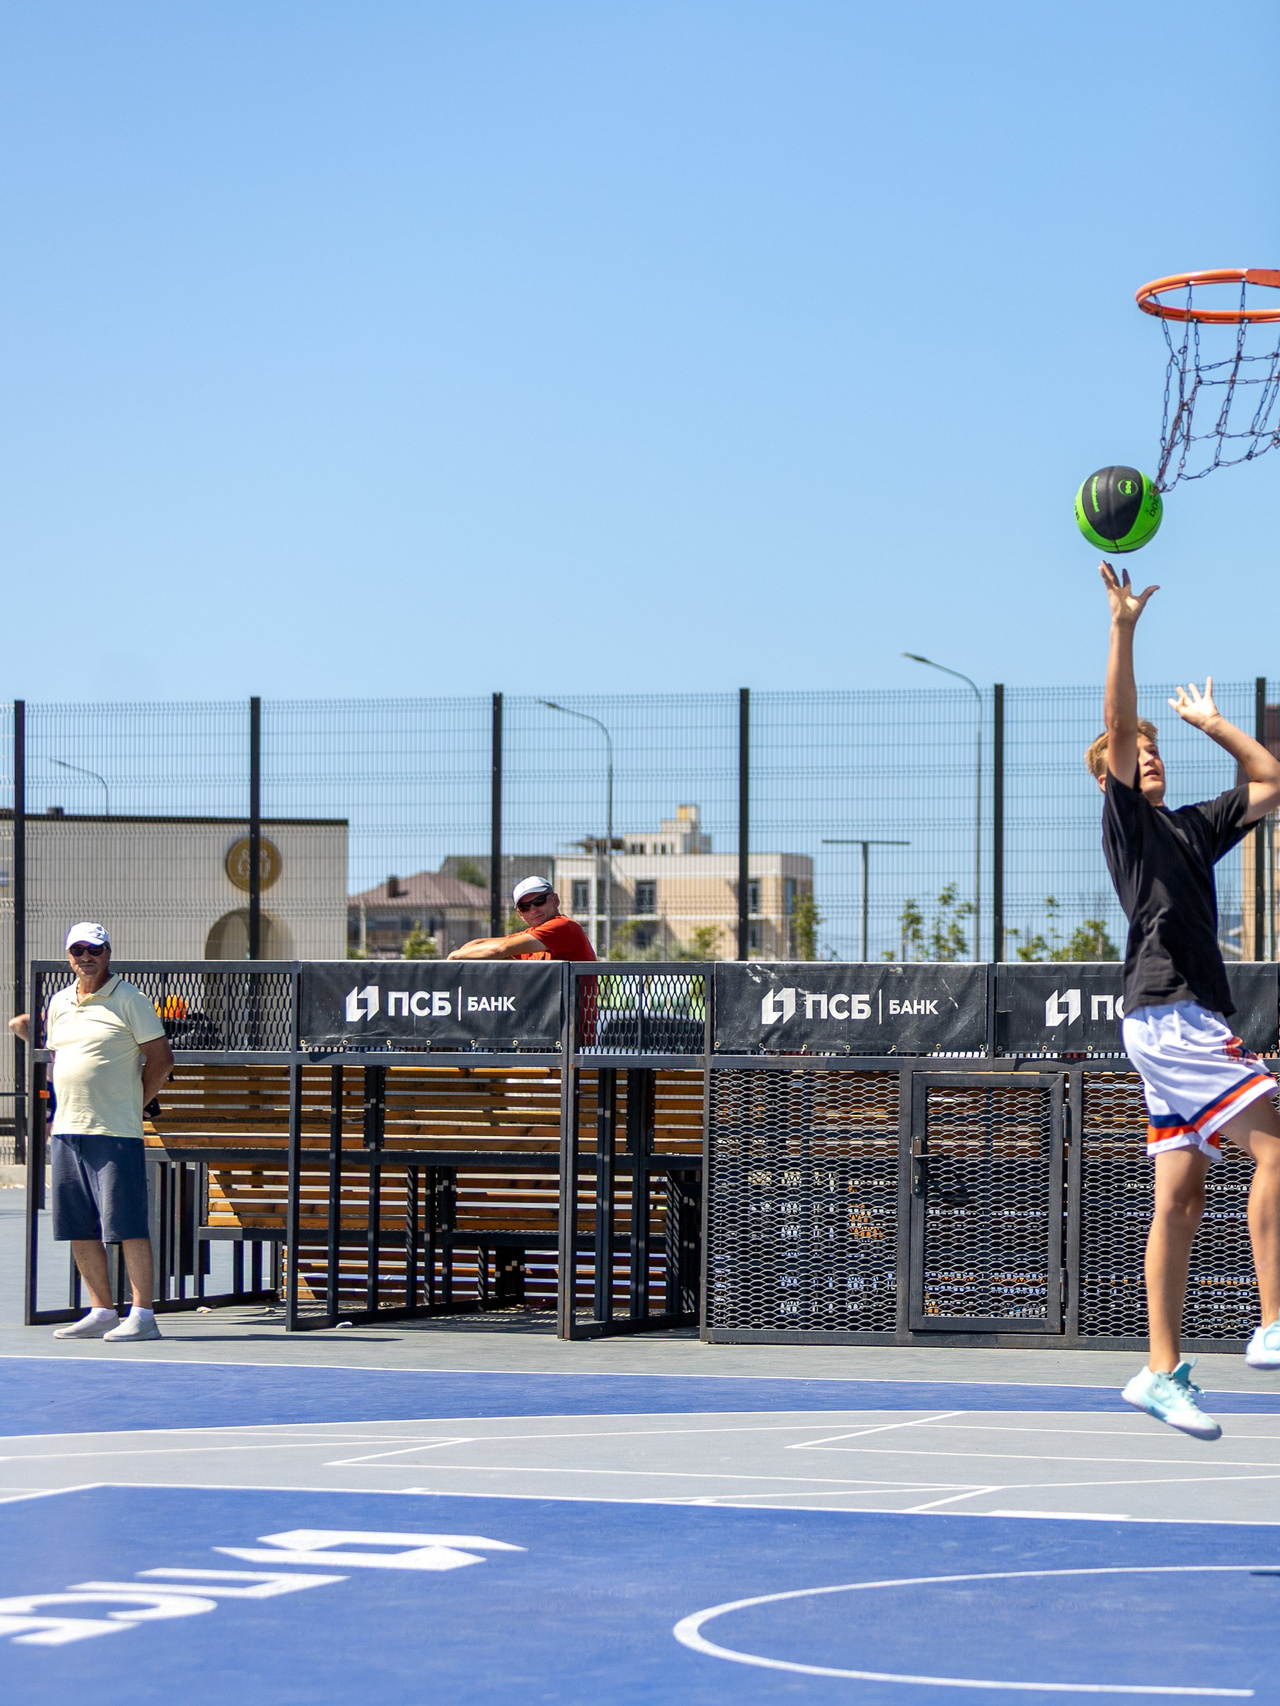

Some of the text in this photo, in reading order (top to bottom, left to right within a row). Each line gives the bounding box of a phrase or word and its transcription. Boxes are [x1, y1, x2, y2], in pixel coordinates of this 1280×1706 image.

[388, 990, 516, 1017] ПСБ БАНК
[805, 993, 939, 1020] ПСБ БАНК
